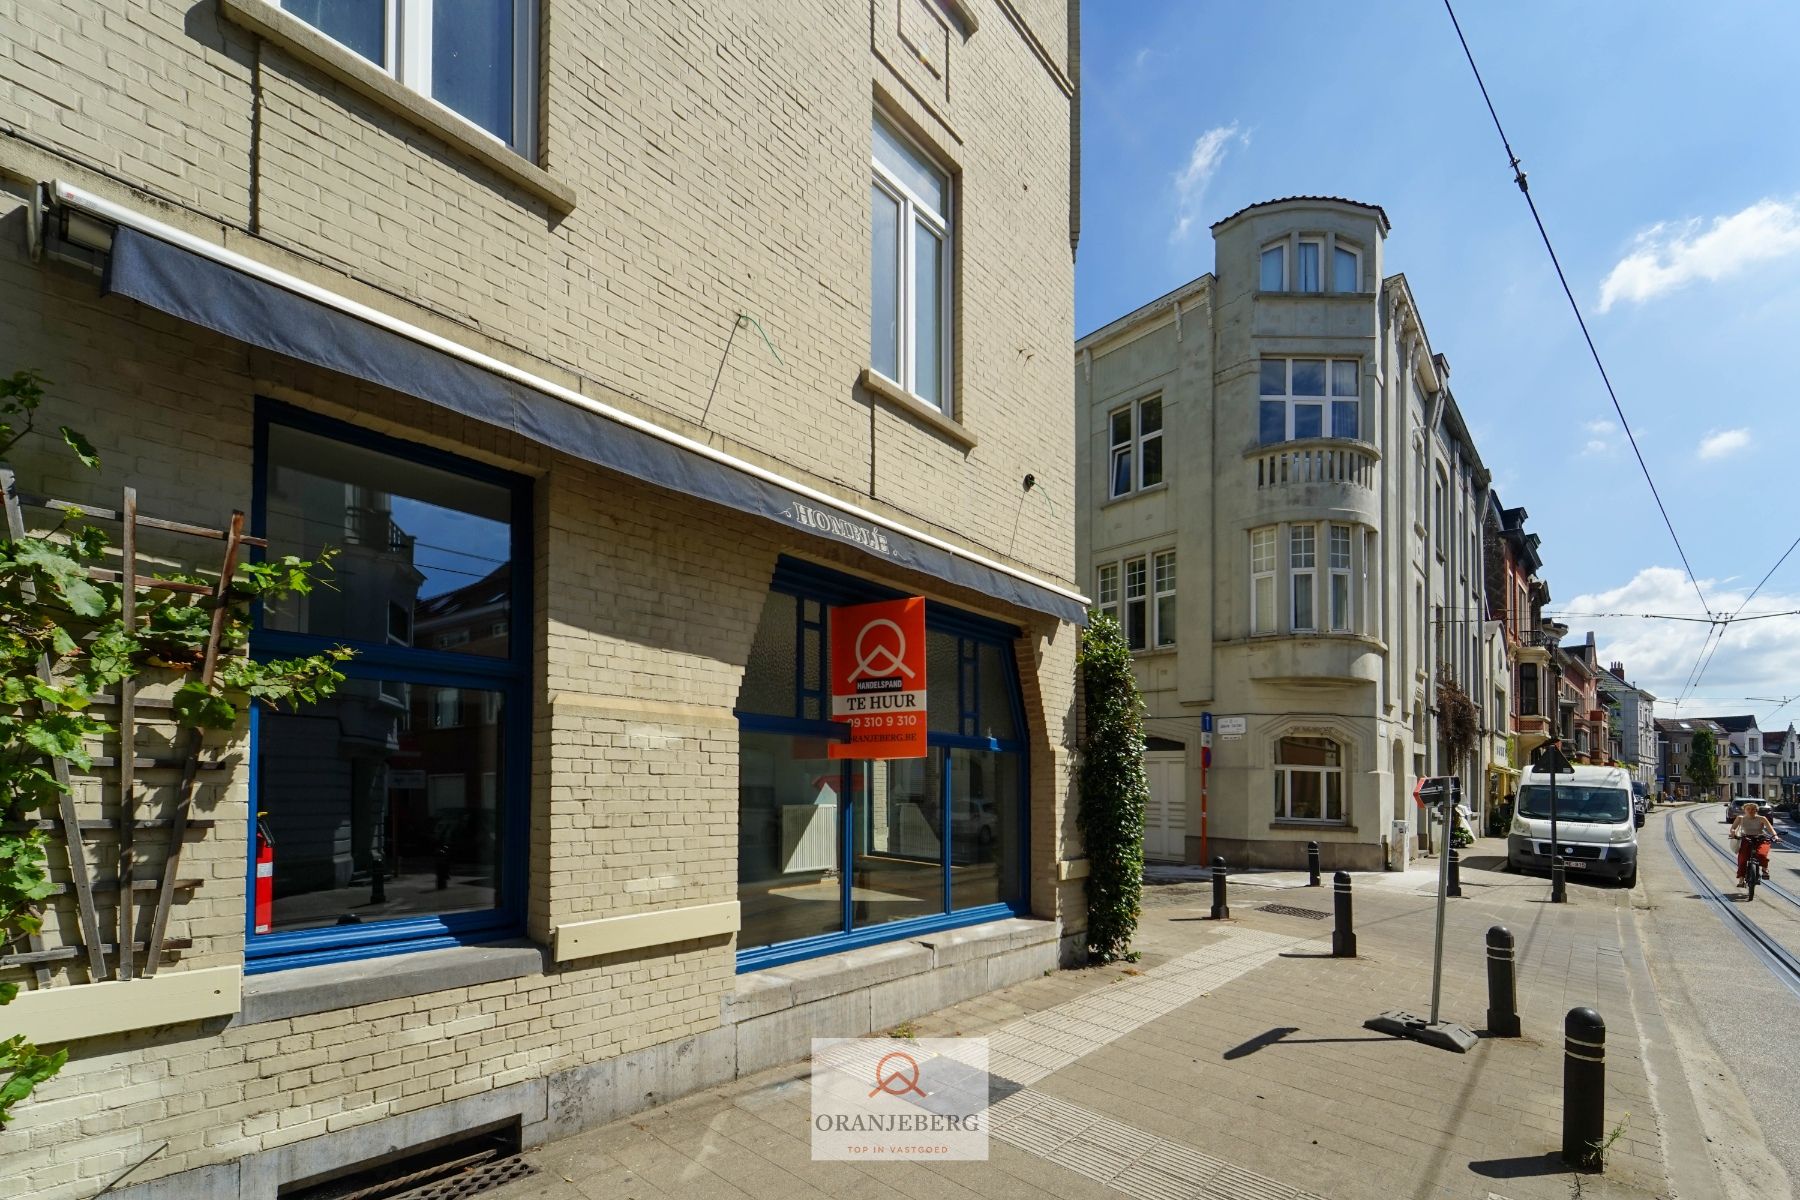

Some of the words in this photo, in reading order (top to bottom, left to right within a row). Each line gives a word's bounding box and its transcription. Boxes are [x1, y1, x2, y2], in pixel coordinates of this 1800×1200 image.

[793, 502, 890, 555] HOMBLÉ
[857, 679, 902, 690] HANDELSPAND
[847, 697, 866, 711] TE
[870, 694, 916, 709] HUUR
[864, 716, 883, 728] 310
[886, 716, 894, 727] 9
[897, 715, 917, 727] 310
[850, 732, 917, 743] RANJEBERG.BE
